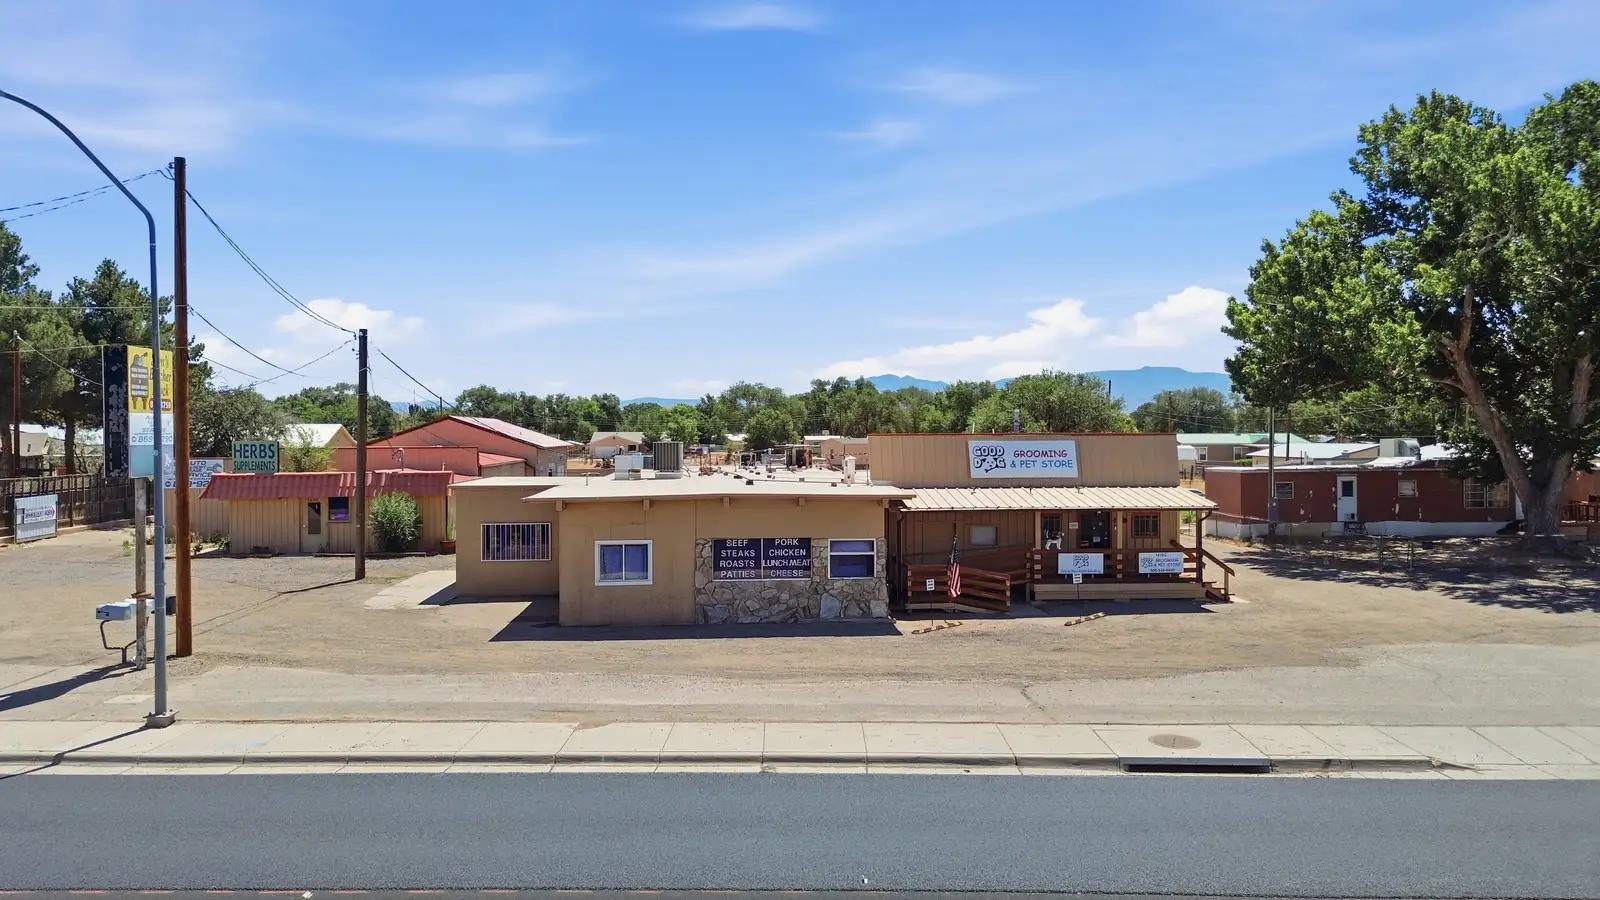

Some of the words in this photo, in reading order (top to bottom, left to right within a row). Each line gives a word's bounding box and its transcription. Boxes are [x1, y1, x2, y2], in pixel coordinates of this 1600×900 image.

[233, 443, 275, 459] HERBS
[972, 446, 1005, 457] GOOD
[1013, 450, 1068, 458] GROOMING
[233, 460, 275, 471] SUPPLEMENTS
[1010, 460, 1017, 468] &
[1020, 460, 1037, 468] PET
[1041, 459, 1073, 468] STORE
[768, 548, 806, 556] CHICKEN
[720, 570, 756, 578] PATTIES
